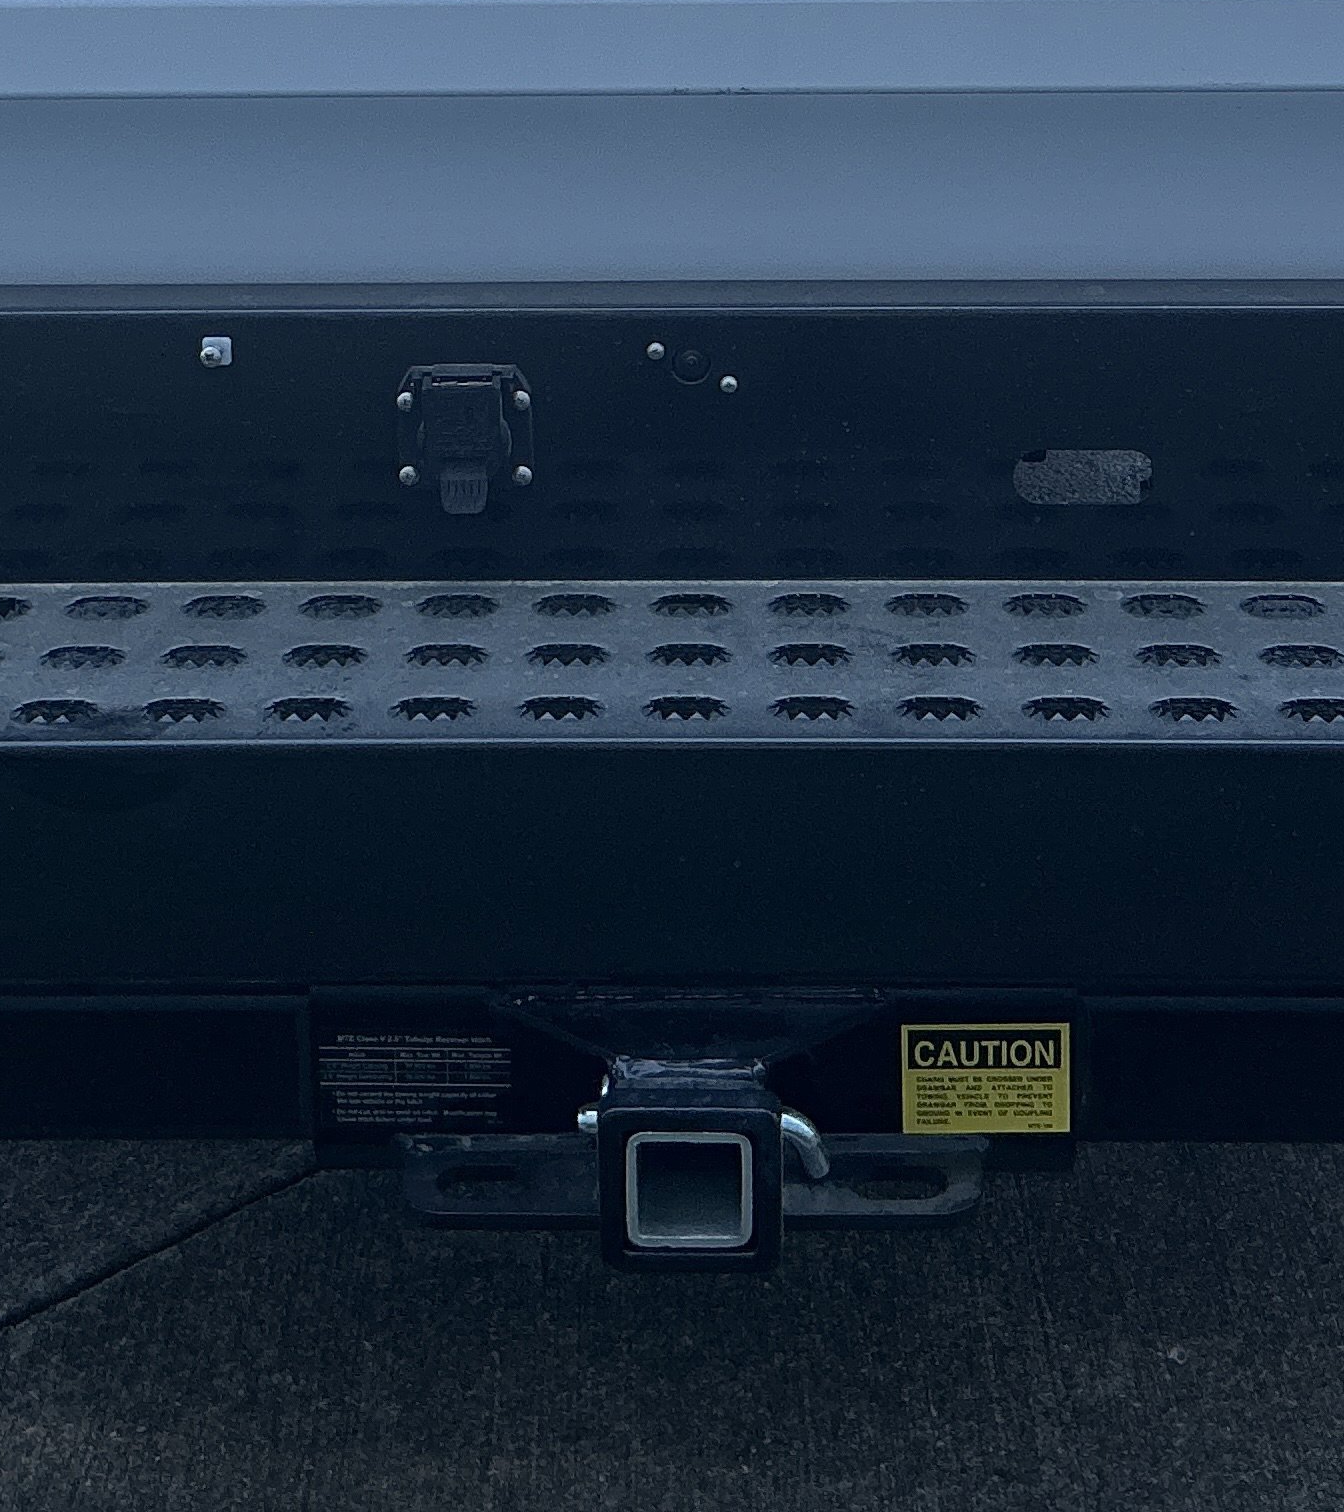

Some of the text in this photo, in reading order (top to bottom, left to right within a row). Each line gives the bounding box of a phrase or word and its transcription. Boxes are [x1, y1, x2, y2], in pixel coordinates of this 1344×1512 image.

[913, 1039, 1056, 1067] CAUTION
[965, 1084, 983, 1092] AND
[1042, 1084, 1053, 1092] TO
